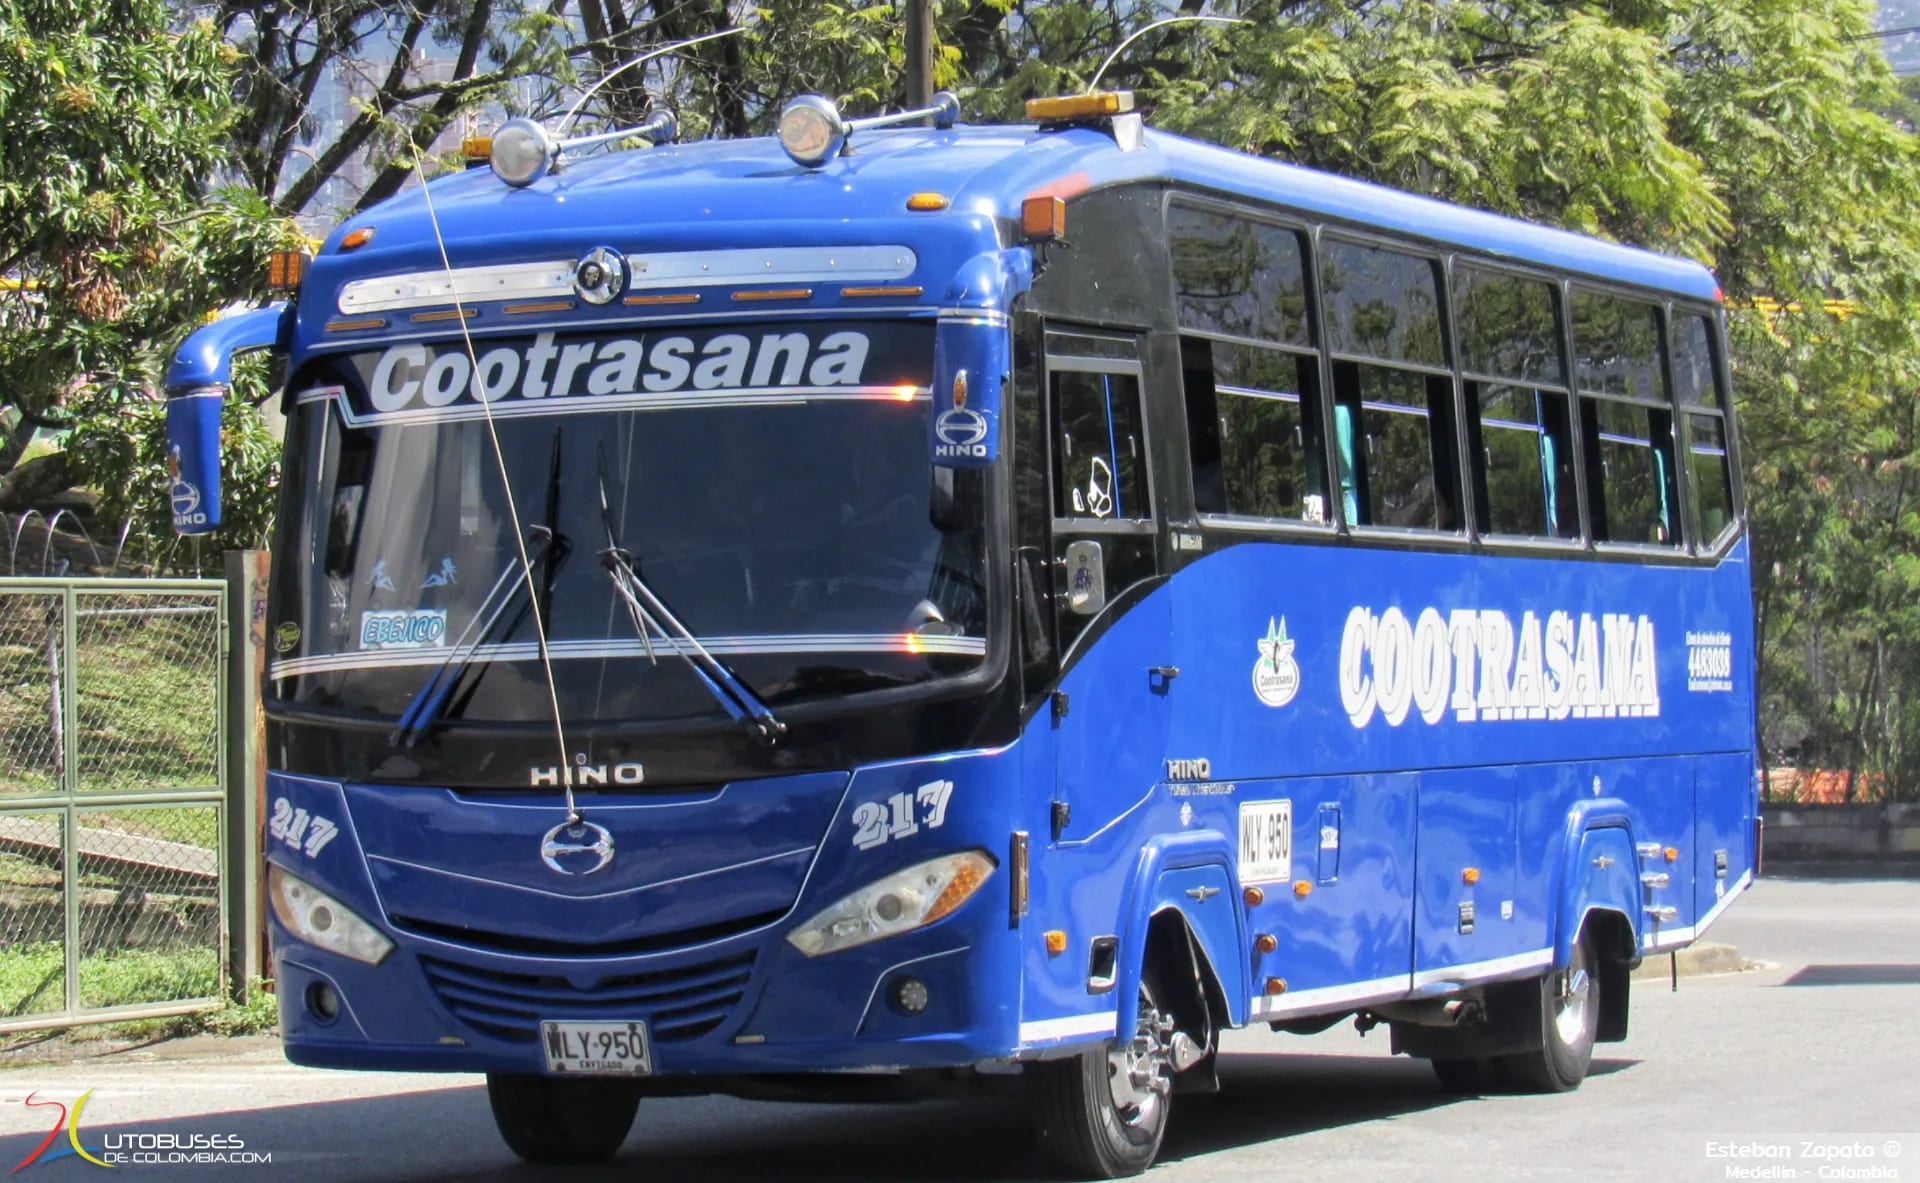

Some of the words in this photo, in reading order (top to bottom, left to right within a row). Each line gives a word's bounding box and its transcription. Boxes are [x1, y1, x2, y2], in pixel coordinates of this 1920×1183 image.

[370, 331, 871, 412] Cootrasana
[936, 445, 987, 457] HINO
[1339, 606, 1660, 728] COOTRASANA
[530, 763, 644, 786] HINO
[1167, 758, 1210, 780] HINO
[270, 797, 339, 858] 217
[852, 779, 954, 850] 217
